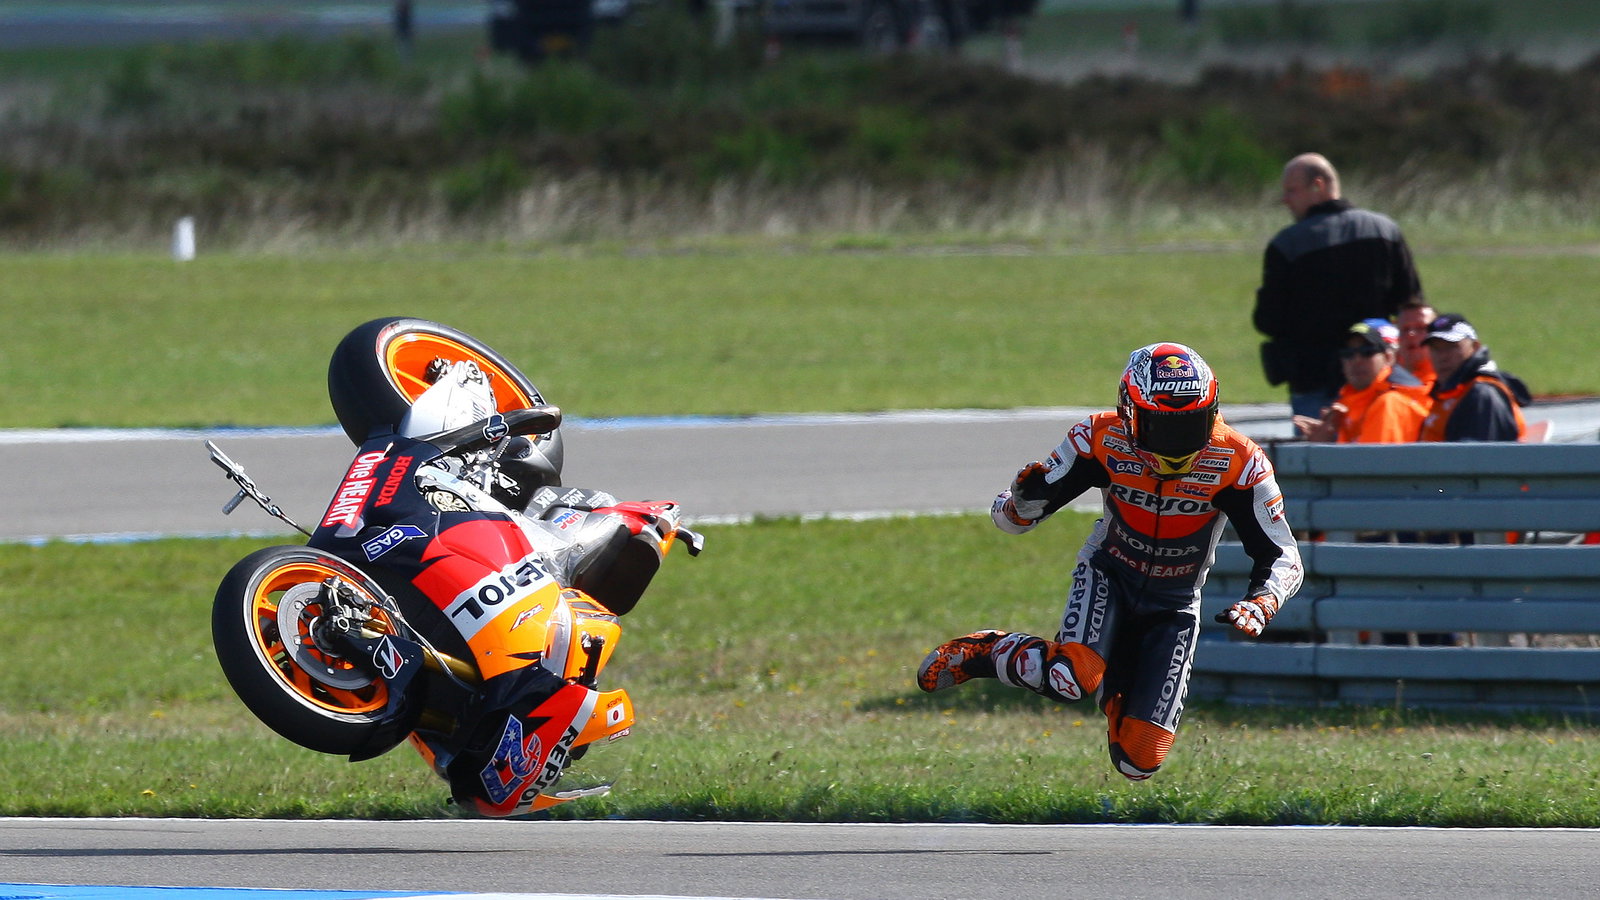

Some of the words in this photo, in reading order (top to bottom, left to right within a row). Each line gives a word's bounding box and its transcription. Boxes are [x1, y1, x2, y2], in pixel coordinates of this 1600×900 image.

[1151, 380, 1201, 396] NOLAN
[1156, 367, 1176, 379] Red
[1176, 367, 1195, 379] Bull
[350, 442, 394, 479] One
[1116, 462, 1142, 474] GAS
[1199, 459, 1229, 467] REPSOL
[374, 455, 415, 508] HONDA
[1175, 483, 1212, 497] HRC
[564, 489, 586, 508] NGK
[1109, 484, 1212, 513] REPSOL
[366, 528, 405, 556] GAS
[1114, 523, 1201, 557] HONDA
[1062, 561, 1087, 642] REPSOL
[1087, 568, 1110, 645] HONDA
[1150, 627, 1191, 723] HONDA
[480, 713, 542, 805] 27
[515, 724, 580, 809] REPSOL
